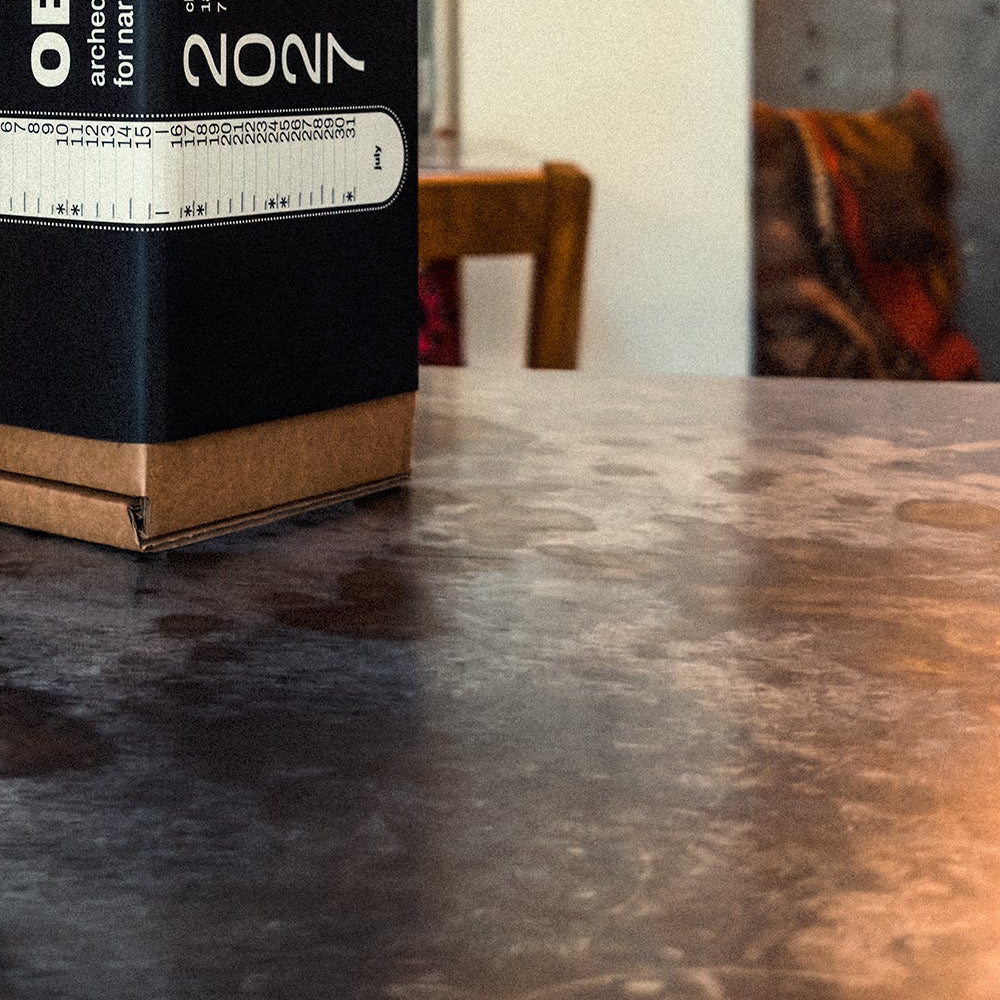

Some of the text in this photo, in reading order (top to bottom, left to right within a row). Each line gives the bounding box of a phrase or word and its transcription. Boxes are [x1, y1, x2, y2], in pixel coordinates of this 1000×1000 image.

[113, 50, 134, 88] for
[183, 32, 365, 86] 2027
[1, 121, 12, 133] 6
[14, 122, 26, 133] 7
[28, 122, 40, 134] 8
[42, 123, 54, 134] 9
[56, 123, 69, 146] 10
[71, 124, 83, 147] 11
[85, 125, 99, 148] 12
[101, 125, 115, 148] 13
[117, 126, 132, 149] 14
[135, 126, 151, 149] 15
[170, 124, 183, 148] 16
[184, 124, 195, 147] 17
[196, 123, 208, 146] 18
[208, 123, 220, 146] 19
[220, 122, 232, 146] 20
[232, 122, 244, 145] 21
[244, 121, 256, 145] 22
[256, 120, 267, 144] 23
[268, 120, 279, 143] 24
[280, 119, 290, 143] 25
[291, 119, 301, 142] 26
[302, 119, 312, 141] 27
[313, 118, 323, 140] 28
[324, 117, 334, 140] 29
[335, 117, 345, 139] 30
[346, 117, 356, 139] 31
[374, 145, 382, 170] july
